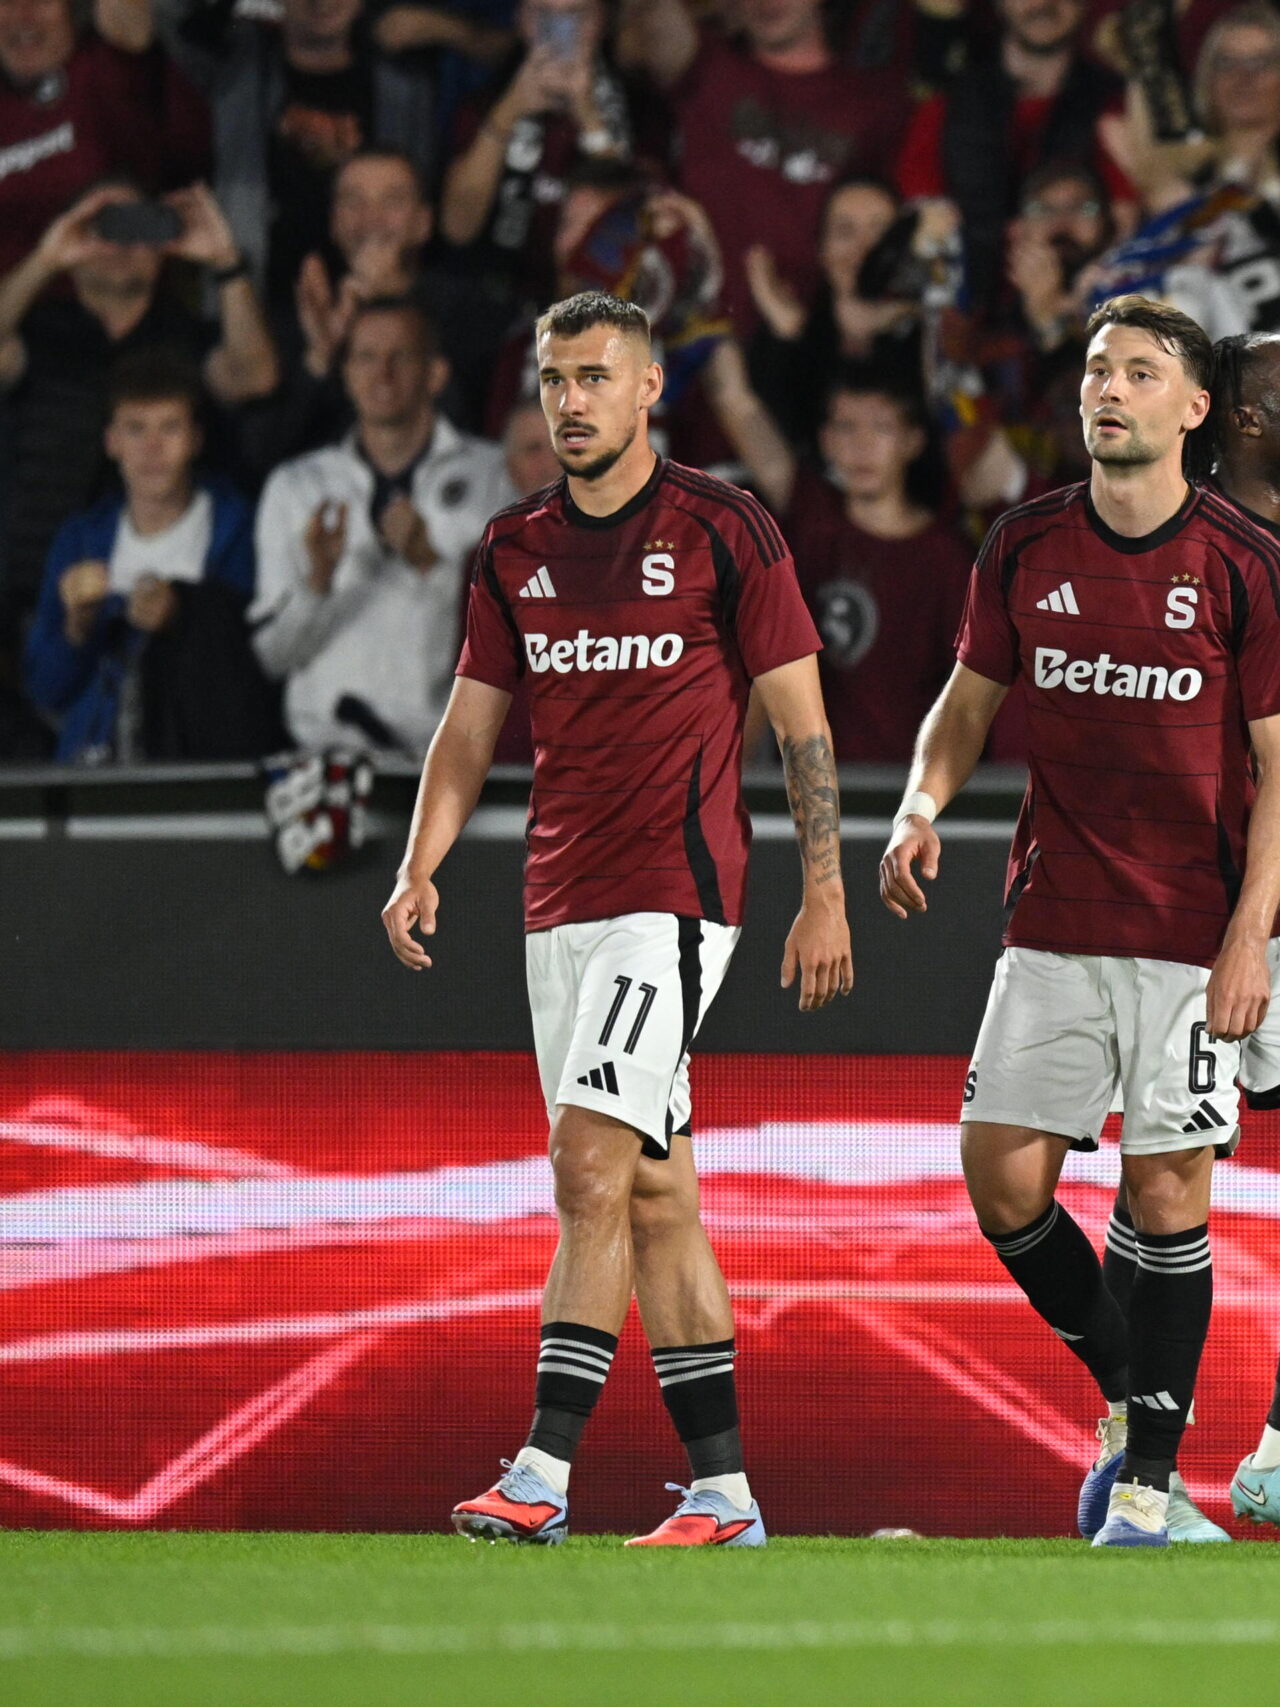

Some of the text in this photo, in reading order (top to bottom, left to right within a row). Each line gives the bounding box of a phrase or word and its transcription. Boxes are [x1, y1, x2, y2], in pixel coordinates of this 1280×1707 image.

[642, 553, 675, 596] S
[1165, 587, 1199, 629] S
[524, 629, 684, 674] Betano
[1034, 646, 1203, 702] Betano
[598, 974, 658, 1056] 11
[1188, 1021, 1217, 1094] 6
[963, 1070, 978, 1103] S
